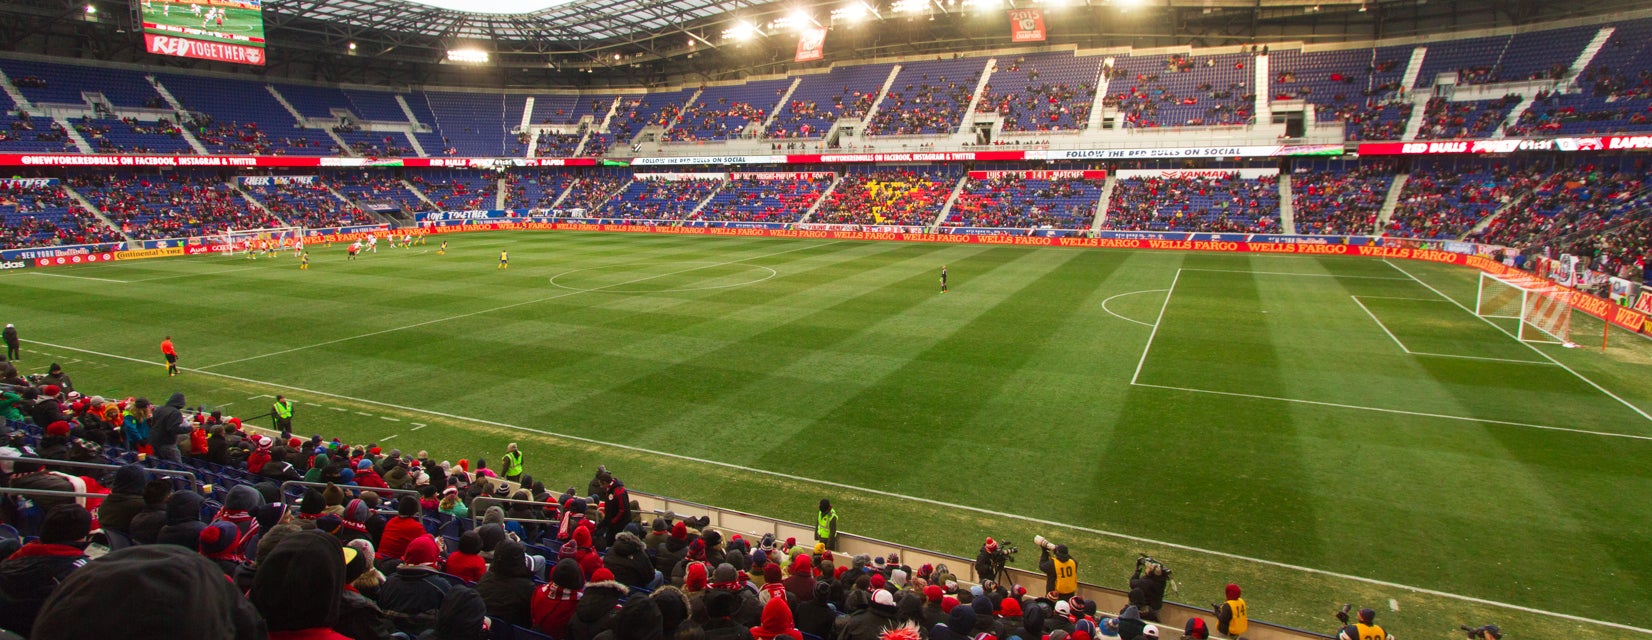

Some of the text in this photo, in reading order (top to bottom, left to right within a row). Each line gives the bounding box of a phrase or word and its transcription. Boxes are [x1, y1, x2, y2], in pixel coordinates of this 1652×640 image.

[1012, 10, 1040, 20] 2015
[1402, 142, 1467, 154] RED BULLS
[21, 156, 118, 165] @NEWYORKREDBULLS
[135, 158, 176, 166] FACEBOOK,
[229, 158, 256, 166] TWITTER
[1032, 171, 1046, 179] 141
[427, 210, 489, 221] LOVE TOGETHER
[401, 228, 431, 237] FARGO
[435, 224, 491, 234] WELLS FARGO
[337, 232, 368, 242] FARGO
[865, 232, 895, 240] FARGO
[903, 234, 970, 243] WELLS FARGO
[978, 236, 1051, 246] WELLS FARGO
[1060, 238, 1140, 248] WELLS FARGO
[1149, 240, 1238, 250] WELLS FARGO
[1248, 242, 1347, 254] WELLS FARGO
[36, 250, 54, 258] YORK
[116, 249, 158, 259] Continental
[1358, 246, 1457, 263] WELLS FARGO
[1060, 566, 1072, 578] 10
[1236, 604, 1245, 618] 14
